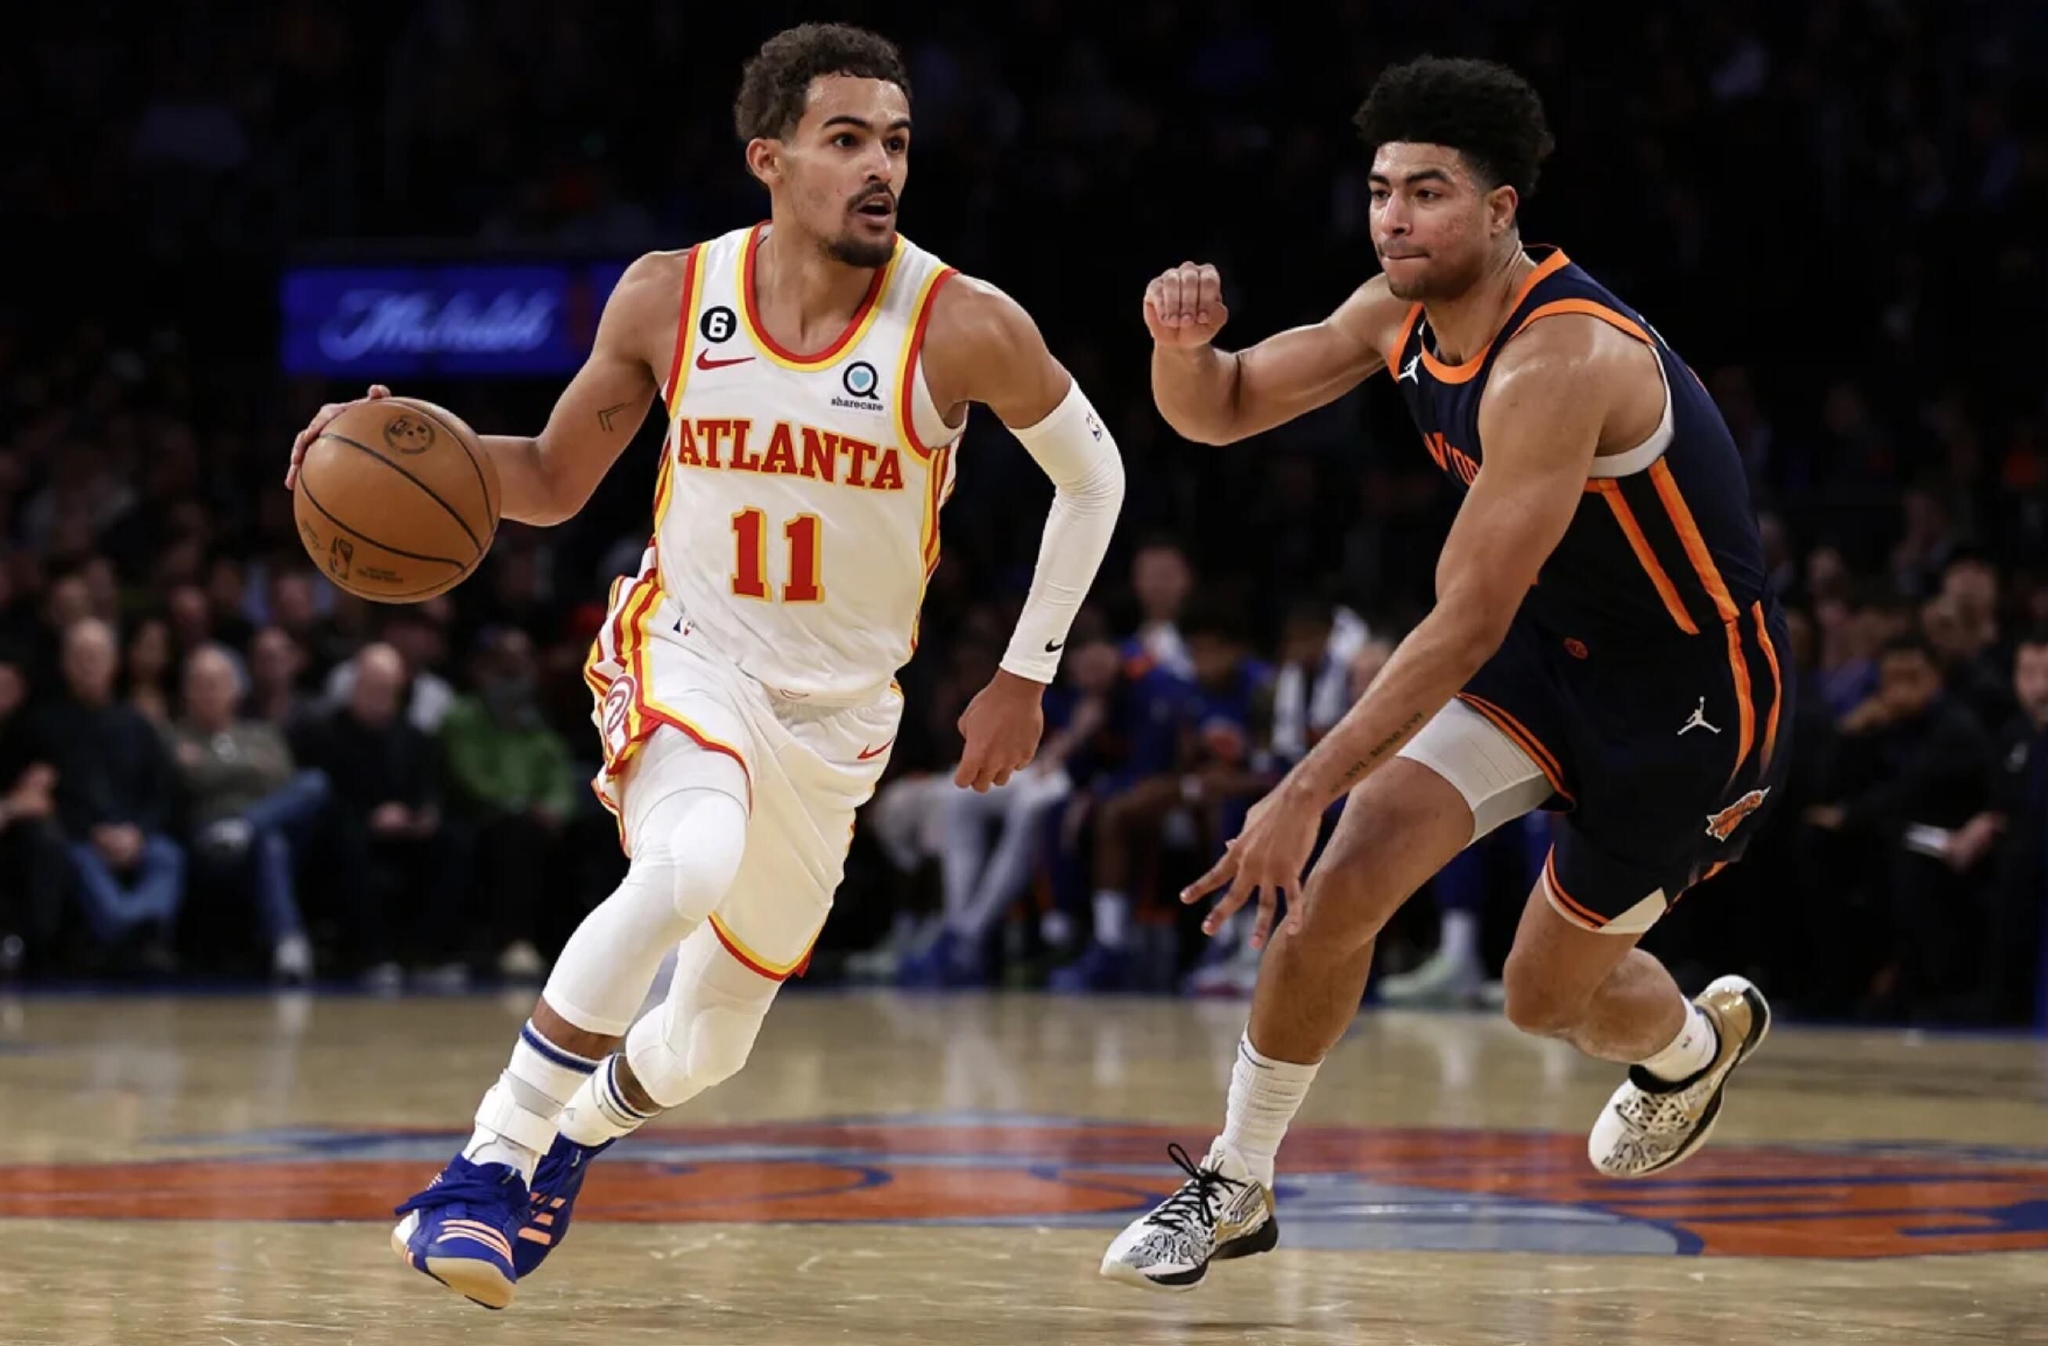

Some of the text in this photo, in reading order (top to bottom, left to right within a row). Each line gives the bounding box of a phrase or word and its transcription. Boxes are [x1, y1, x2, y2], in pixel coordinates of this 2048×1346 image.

[708, 309, 729, 339] 6
[831, 396, 884, 411] sharecare
[678, 418, 904, 490] ATLANTA
[730, 506, 825, 603] 11
